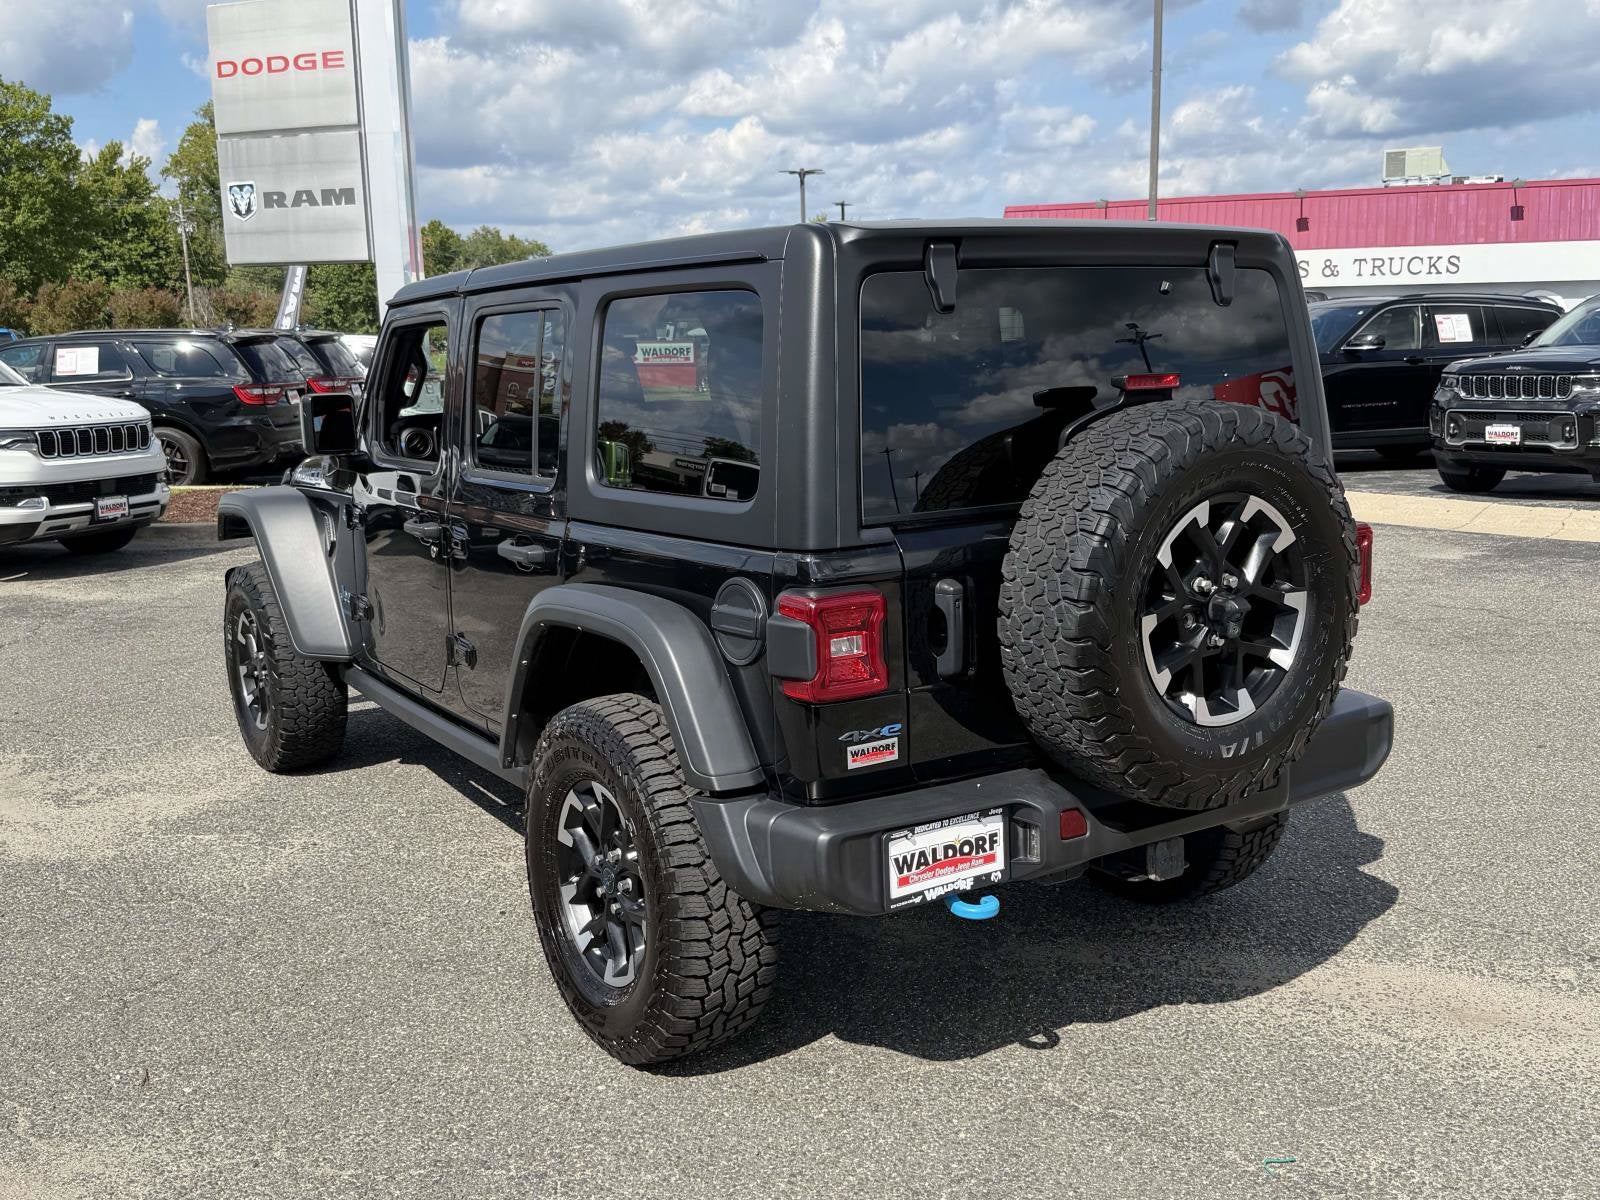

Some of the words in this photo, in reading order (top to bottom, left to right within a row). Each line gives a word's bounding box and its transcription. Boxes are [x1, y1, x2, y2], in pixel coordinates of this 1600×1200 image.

[216, 51, 345, 78] DODGE
[263, 187, 356, 209] RAM
[1321, 258, 1339, 278] &
[1353, 255, 1461, 277] TRUCKS
[641, 346, 691, 358] WALDORF
[850, 742, 896, 759] WALDORF
[914, 821, 941, 834] DEDICATED
[942, 819, 949, 827] TO
[950, 812, 980, 825] EXCELLENCE
[893, 832, 998, 875] WALDORF
[924, 877, 974, 901] WALDORF
